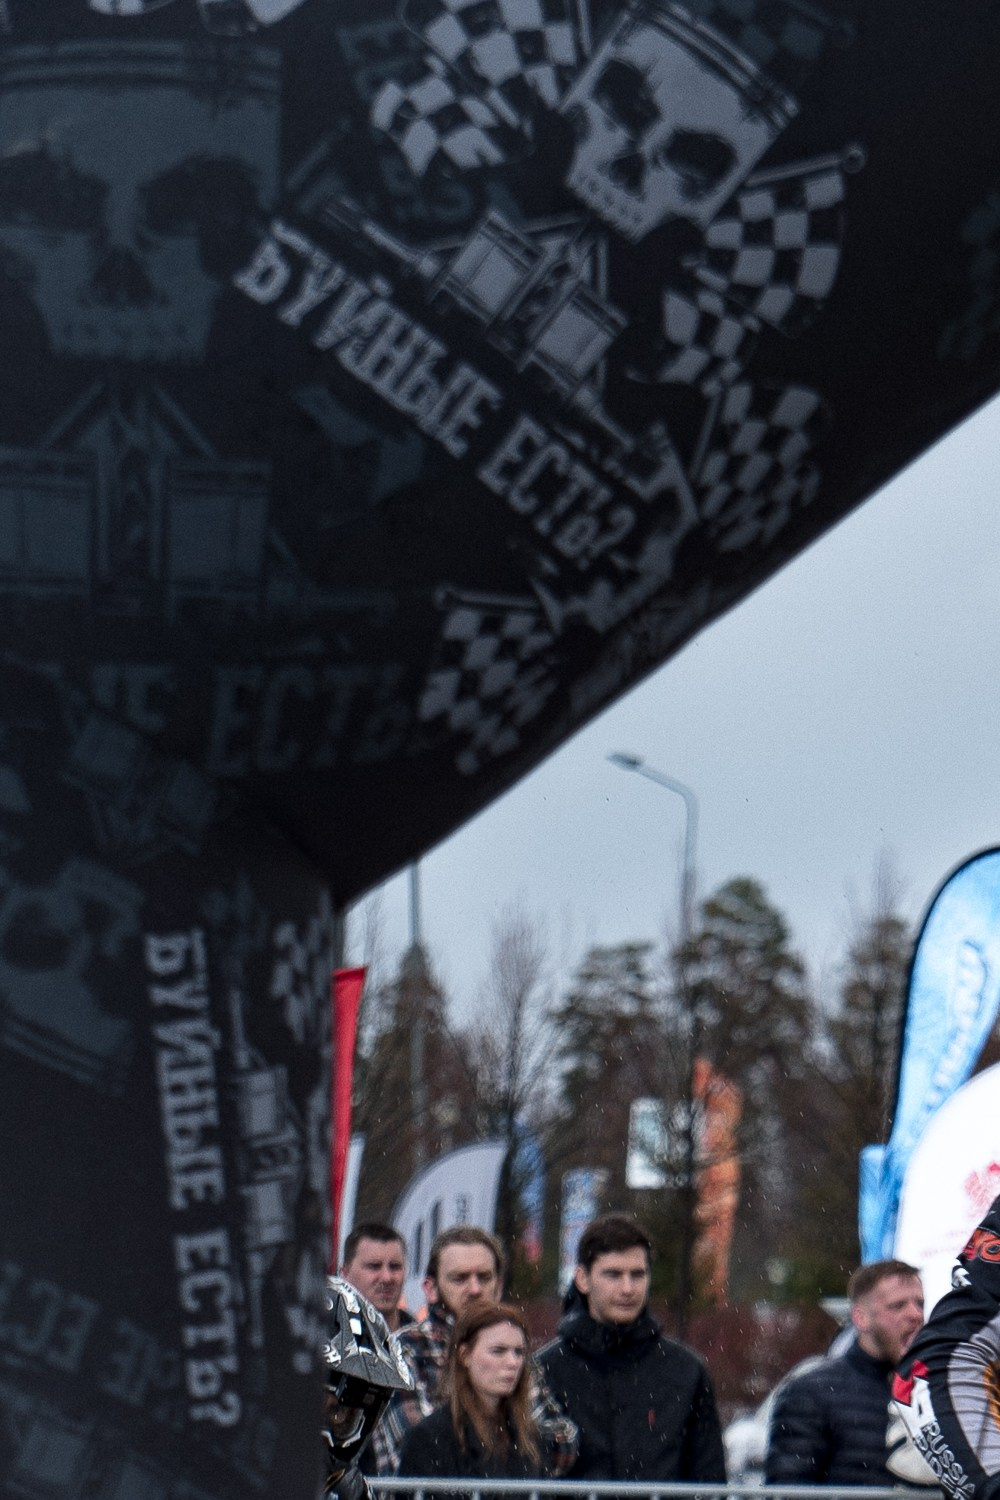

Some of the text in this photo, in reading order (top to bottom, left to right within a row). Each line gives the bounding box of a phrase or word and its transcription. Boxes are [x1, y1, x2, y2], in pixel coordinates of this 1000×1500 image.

[234, 218, 636, 570] БУЙНЫЕ ЕСТЬ?
[143, 927, 241, 1428] БУЙНЫЕ ЕСТЬ?
